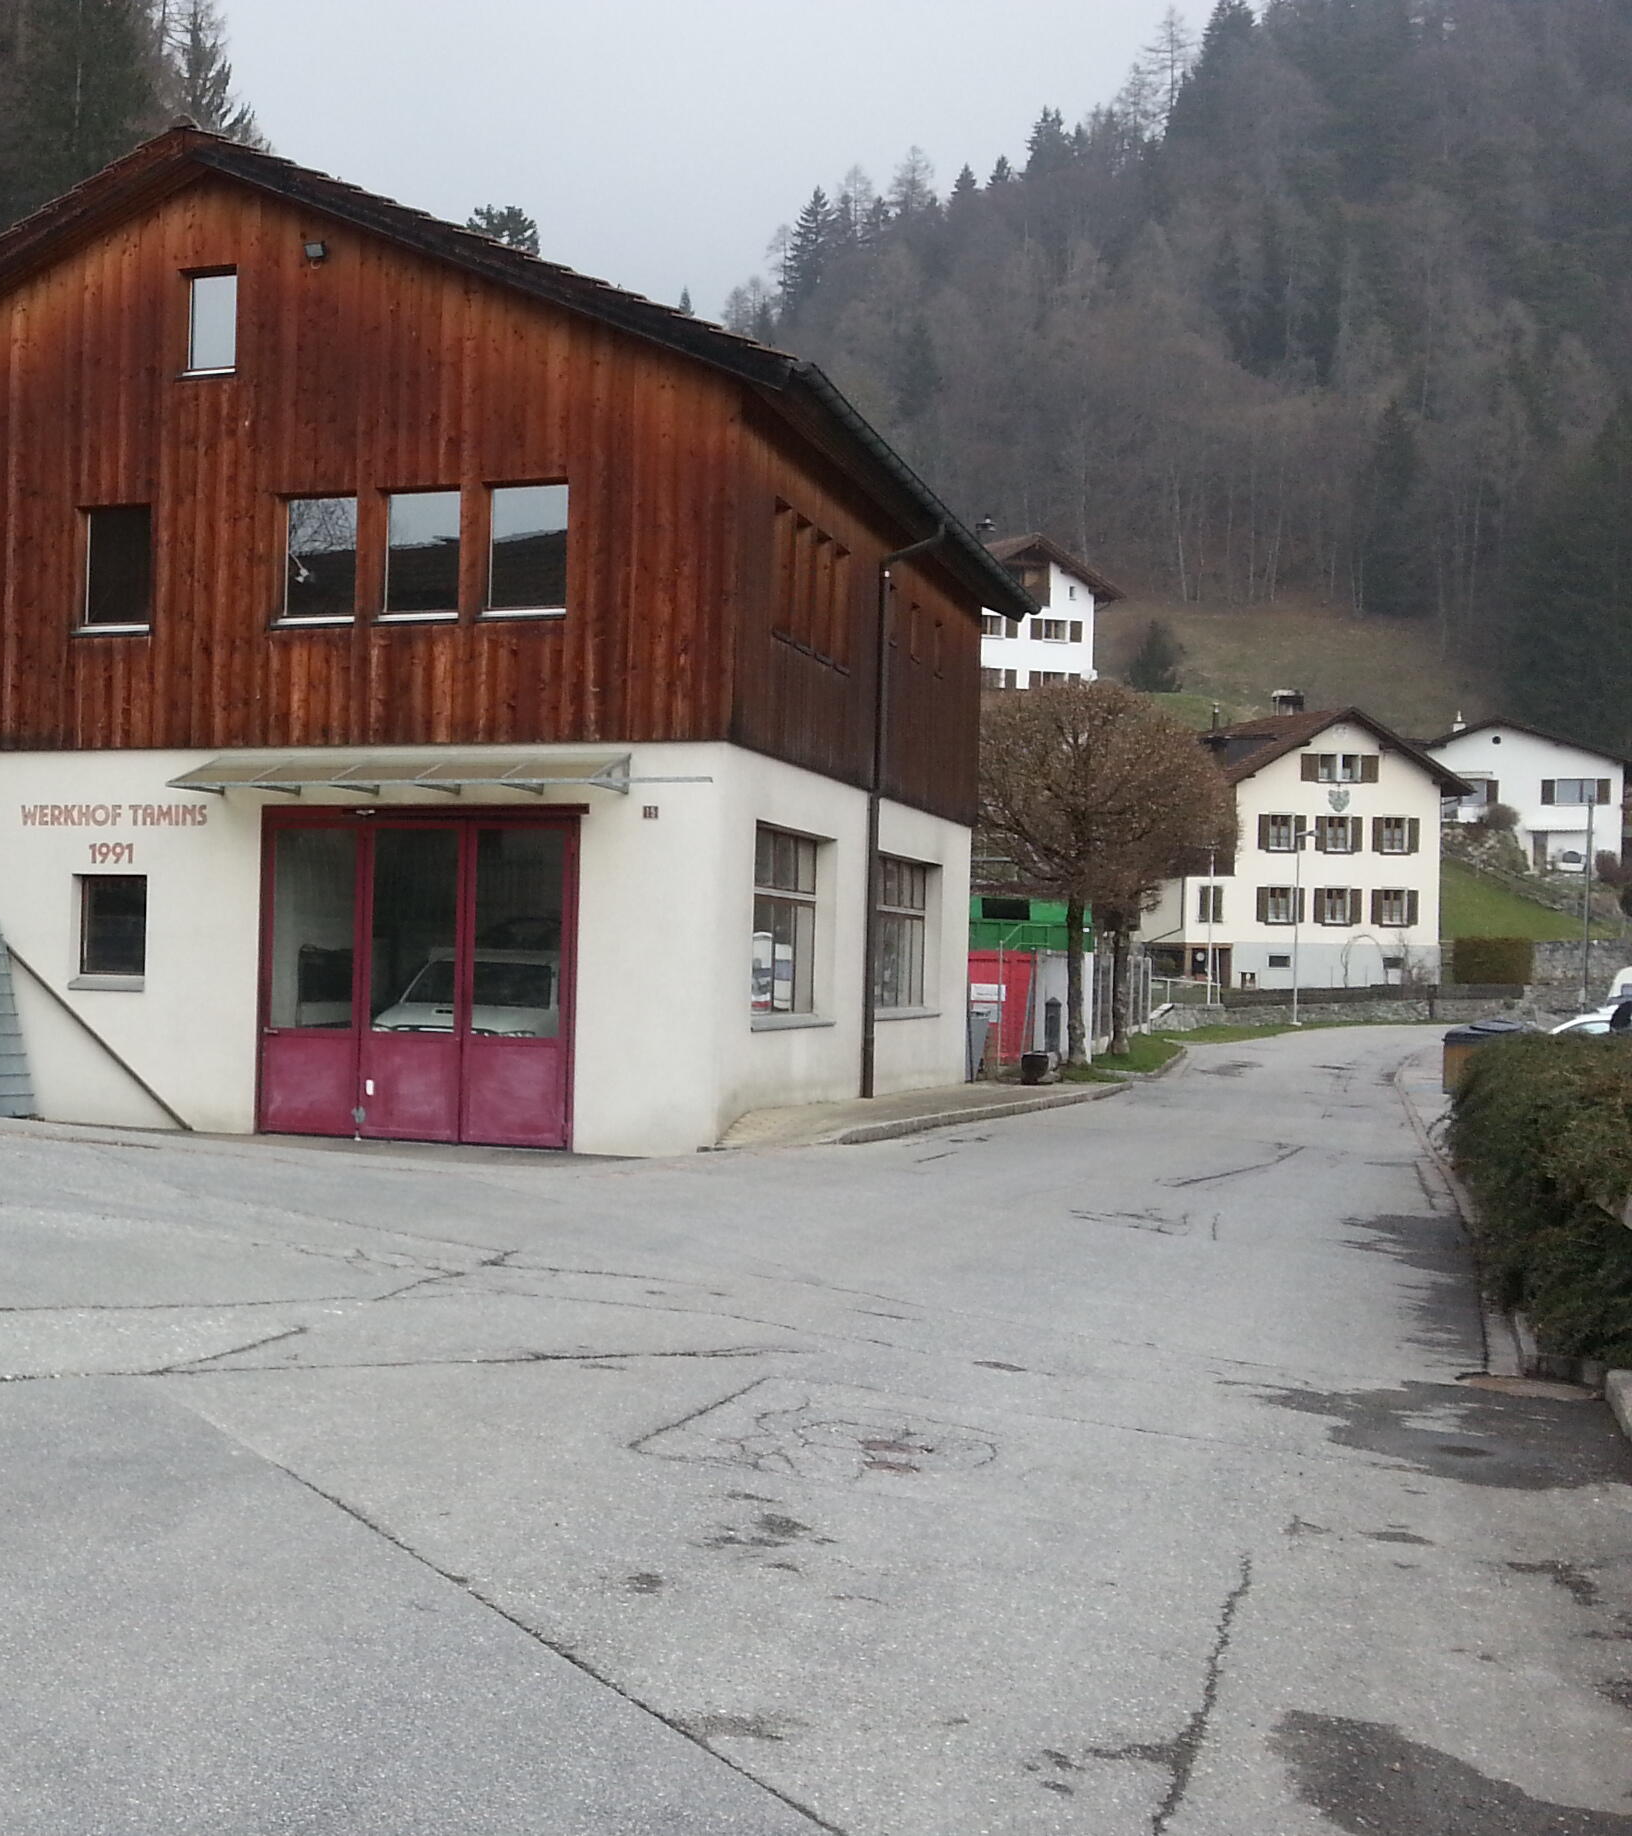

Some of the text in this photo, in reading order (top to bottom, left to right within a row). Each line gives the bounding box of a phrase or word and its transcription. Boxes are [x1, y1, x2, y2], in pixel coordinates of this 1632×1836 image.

[20, 804, 207, 827] WERKHOF TAMINS
[88, 842, 134, 864] 1991
